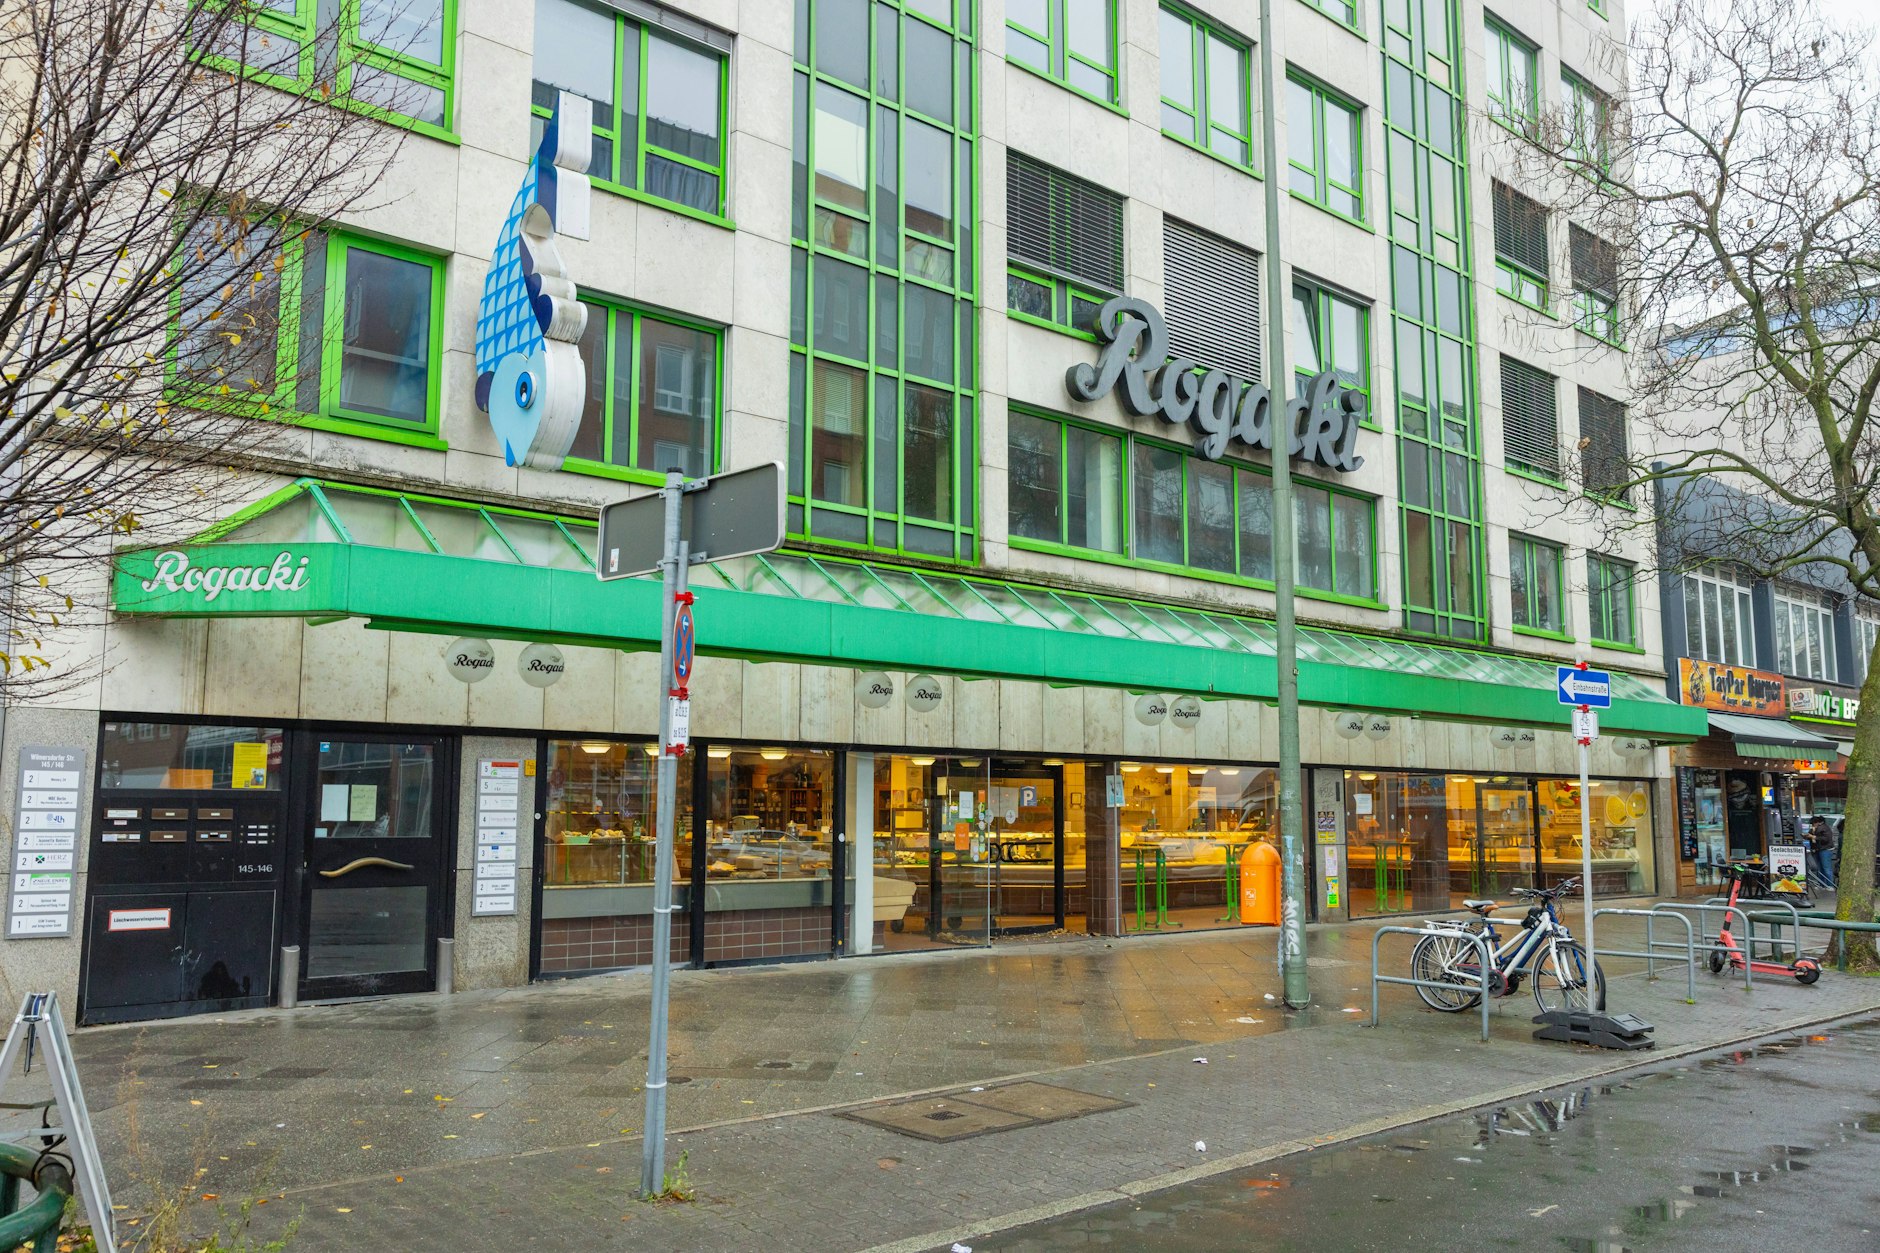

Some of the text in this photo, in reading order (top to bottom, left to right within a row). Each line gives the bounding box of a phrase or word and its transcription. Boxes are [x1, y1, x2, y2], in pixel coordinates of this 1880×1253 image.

[1065, 296, 1365, 473] Rogacki
[141, 550, 311, 602] Rogacki
[1573, 682, 1607, 694] Einbahnstraße
[30, 753, 75, 762] Wilmersdorfer Str.
[484, 765, 489, 773] 5
[28, 774, 34, 783] 2
[484, 781, 489, 790] 5
[27, 795, 32, 804] 2
[25, 816, 31, 825] 2
[23, 837, 29, 846] 2
[22, 857, 27, 866] 2
[238, 864, 273, 873] 145-146
[480, 866, 485, 874] 2
[20, 878, 26, 887] 2
[480, 883, 484, 891] 2
[18, 899, 24, 908] 2
[479, 900, 483, 908] 2
[17, 920, 21, 929] 1
